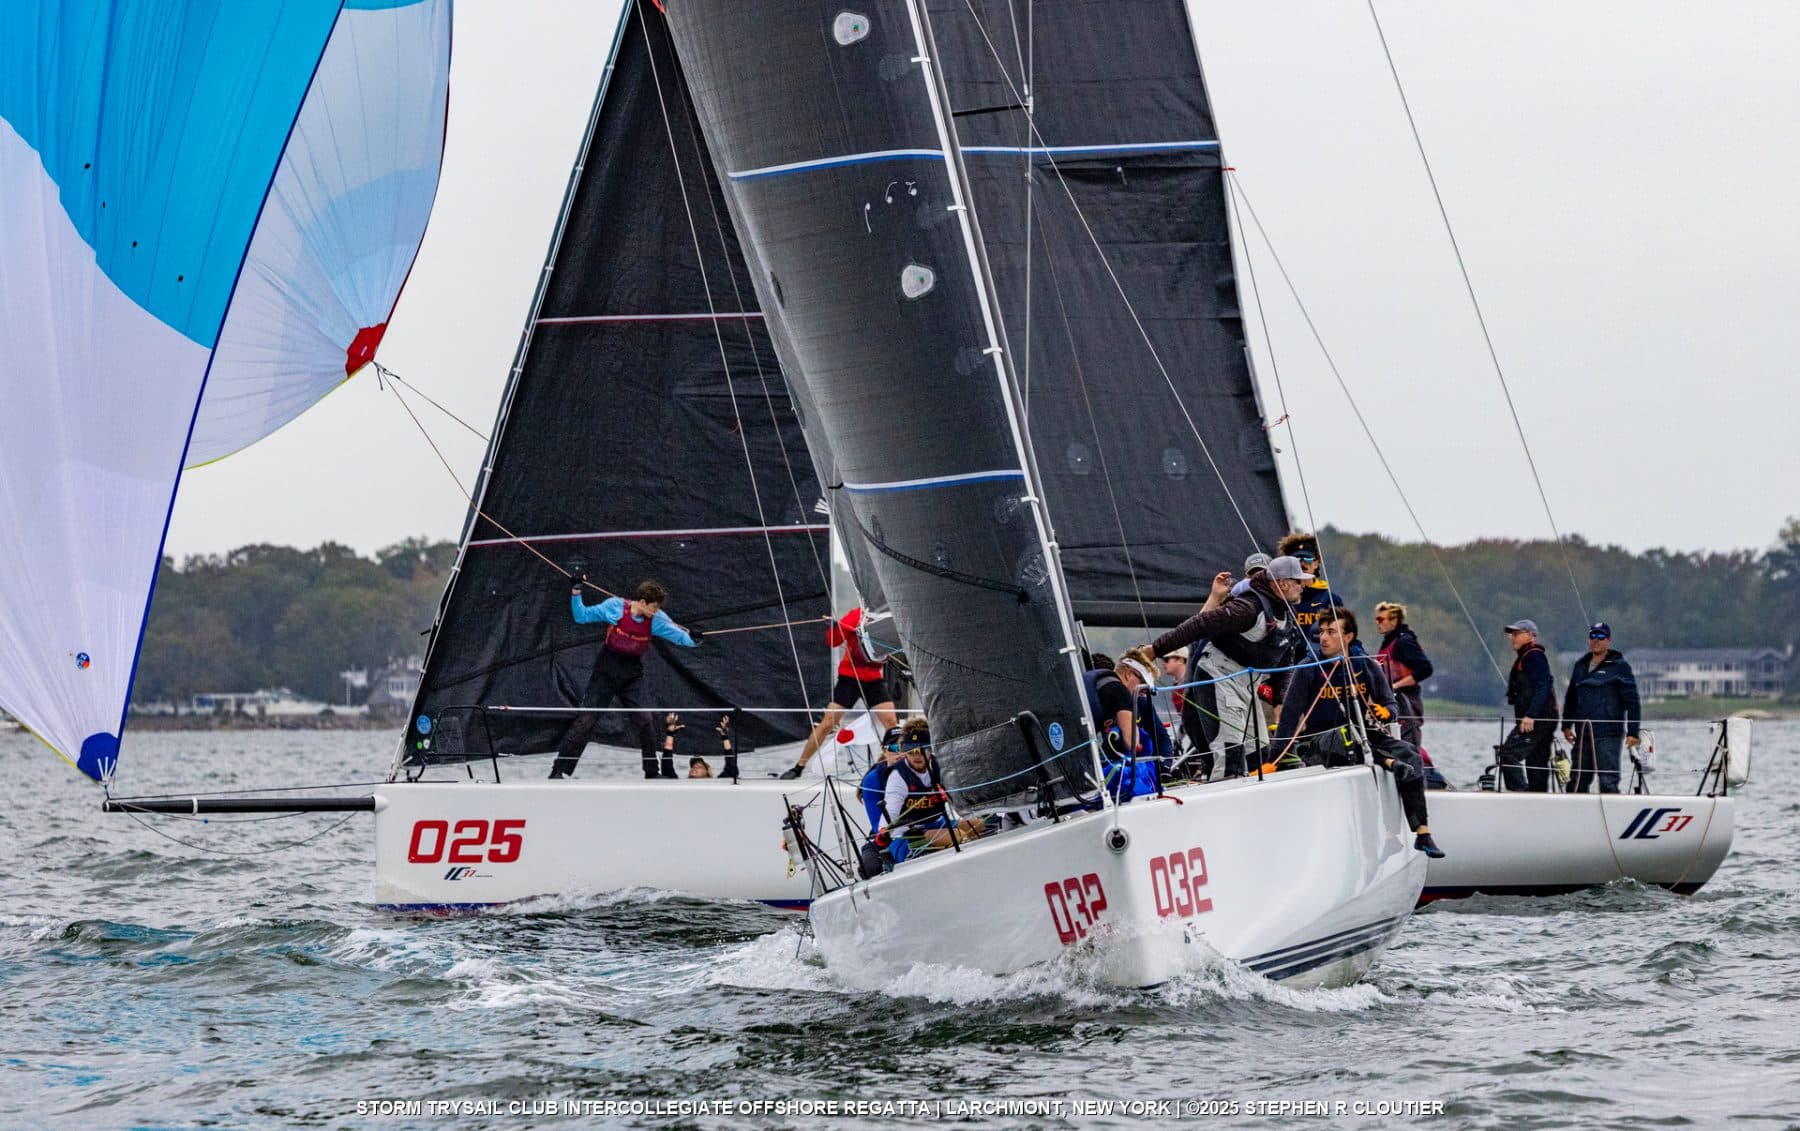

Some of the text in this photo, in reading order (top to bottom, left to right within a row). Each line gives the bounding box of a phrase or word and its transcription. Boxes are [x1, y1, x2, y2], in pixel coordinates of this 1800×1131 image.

[407, 819, 527, 864] 025
[1044, 872, 1108, 946] 032
[1149, 846, 1214, 919] 032
